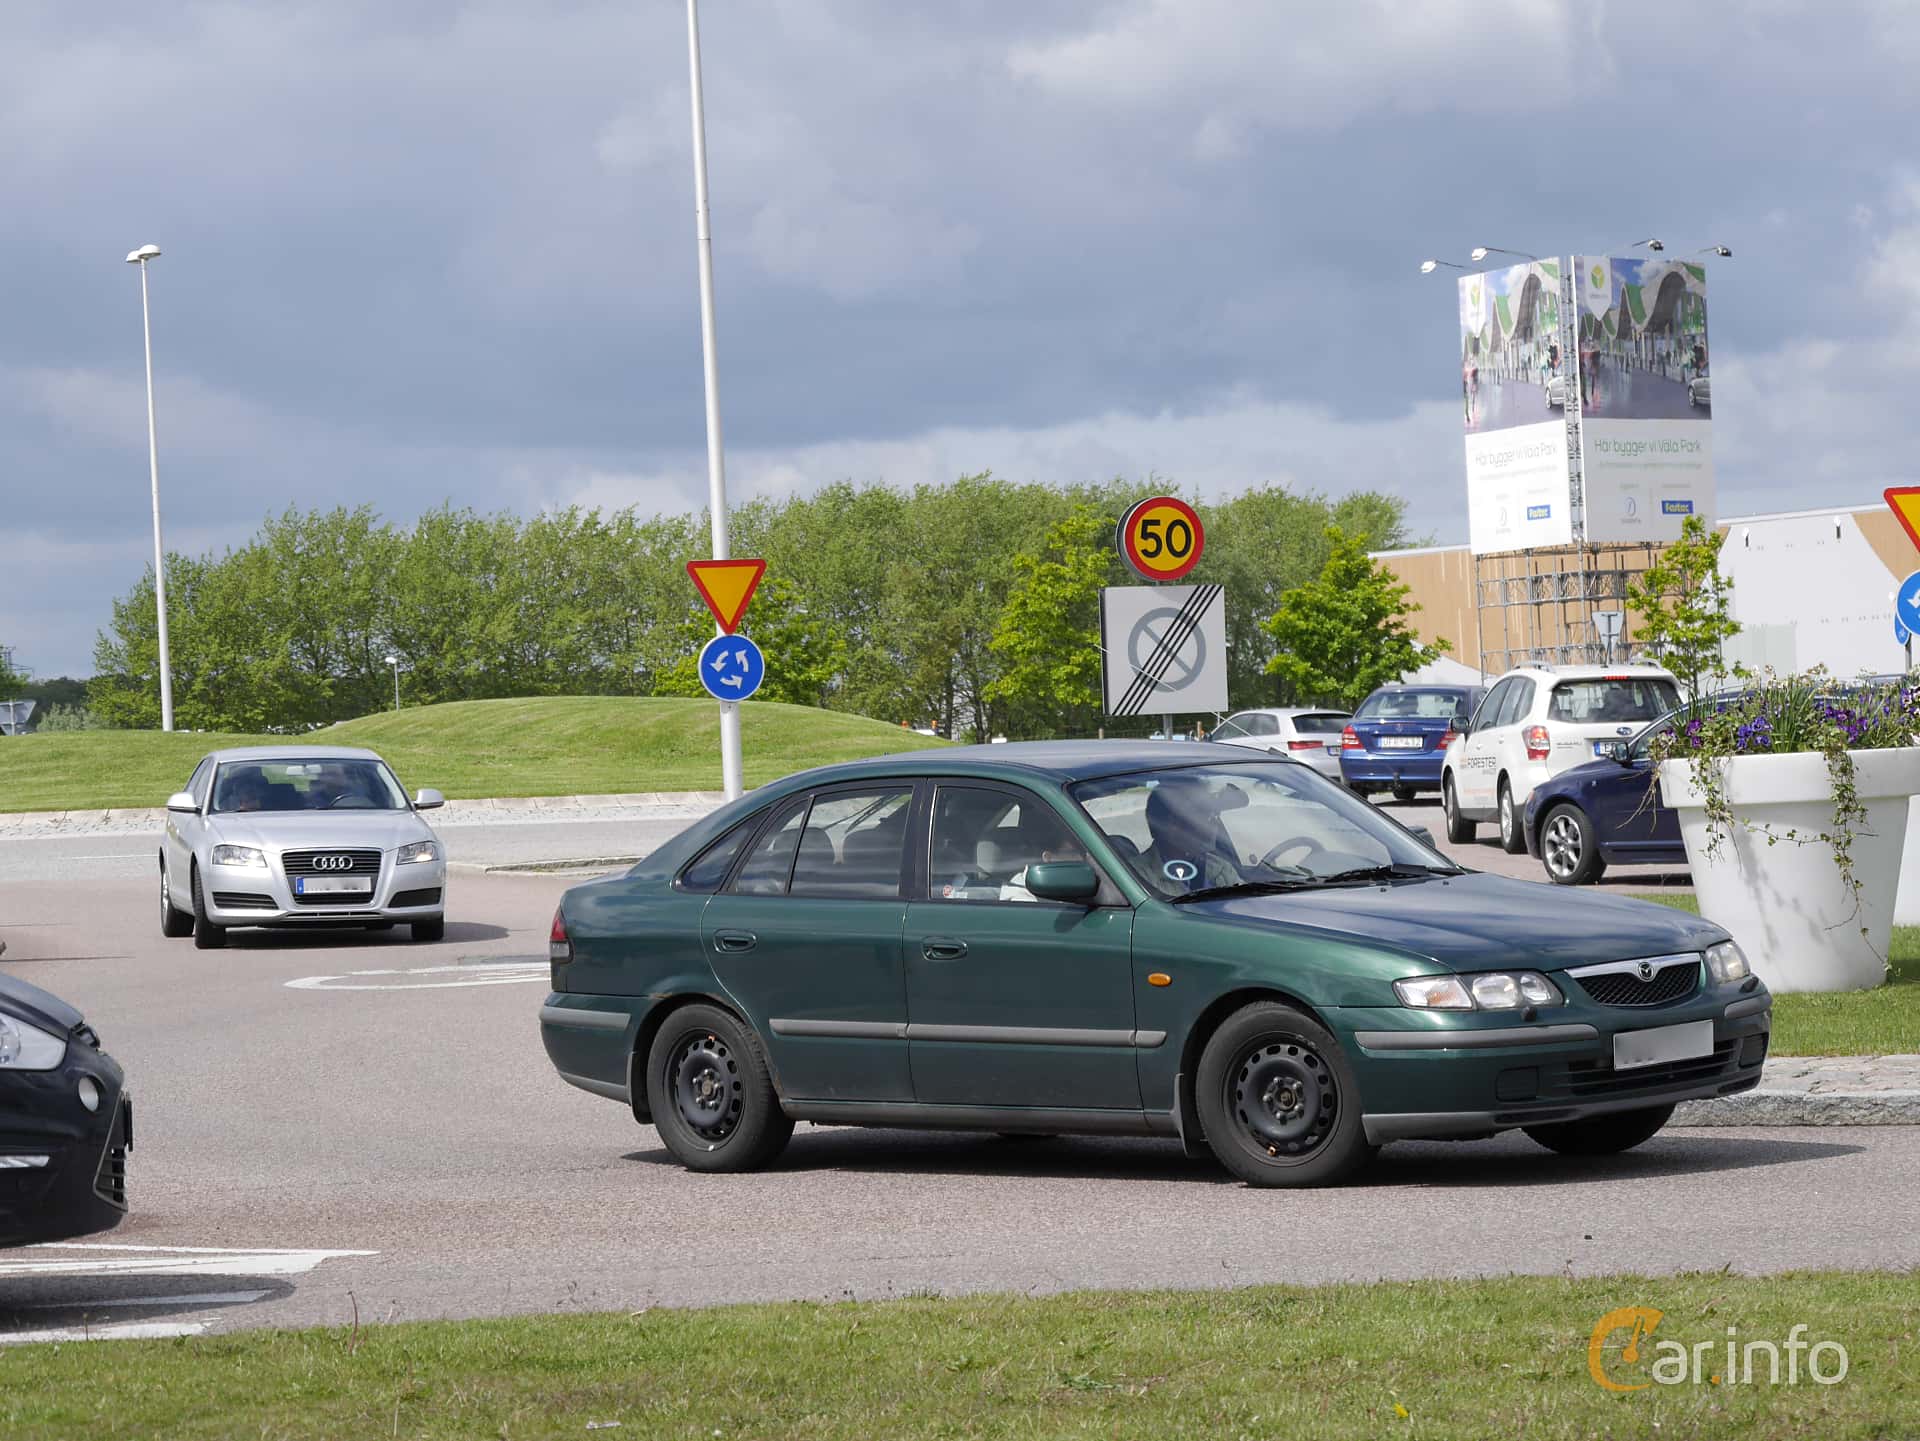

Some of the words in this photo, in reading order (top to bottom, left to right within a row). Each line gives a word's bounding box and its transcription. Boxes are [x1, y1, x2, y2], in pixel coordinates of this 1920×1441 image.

[1613, 438, 1647, 456] bygger
[1680, 439, 1702, 453] Park
[1140, 519, 1192, 559] 50
[1467, 756, 1497, 768] FORESTER
